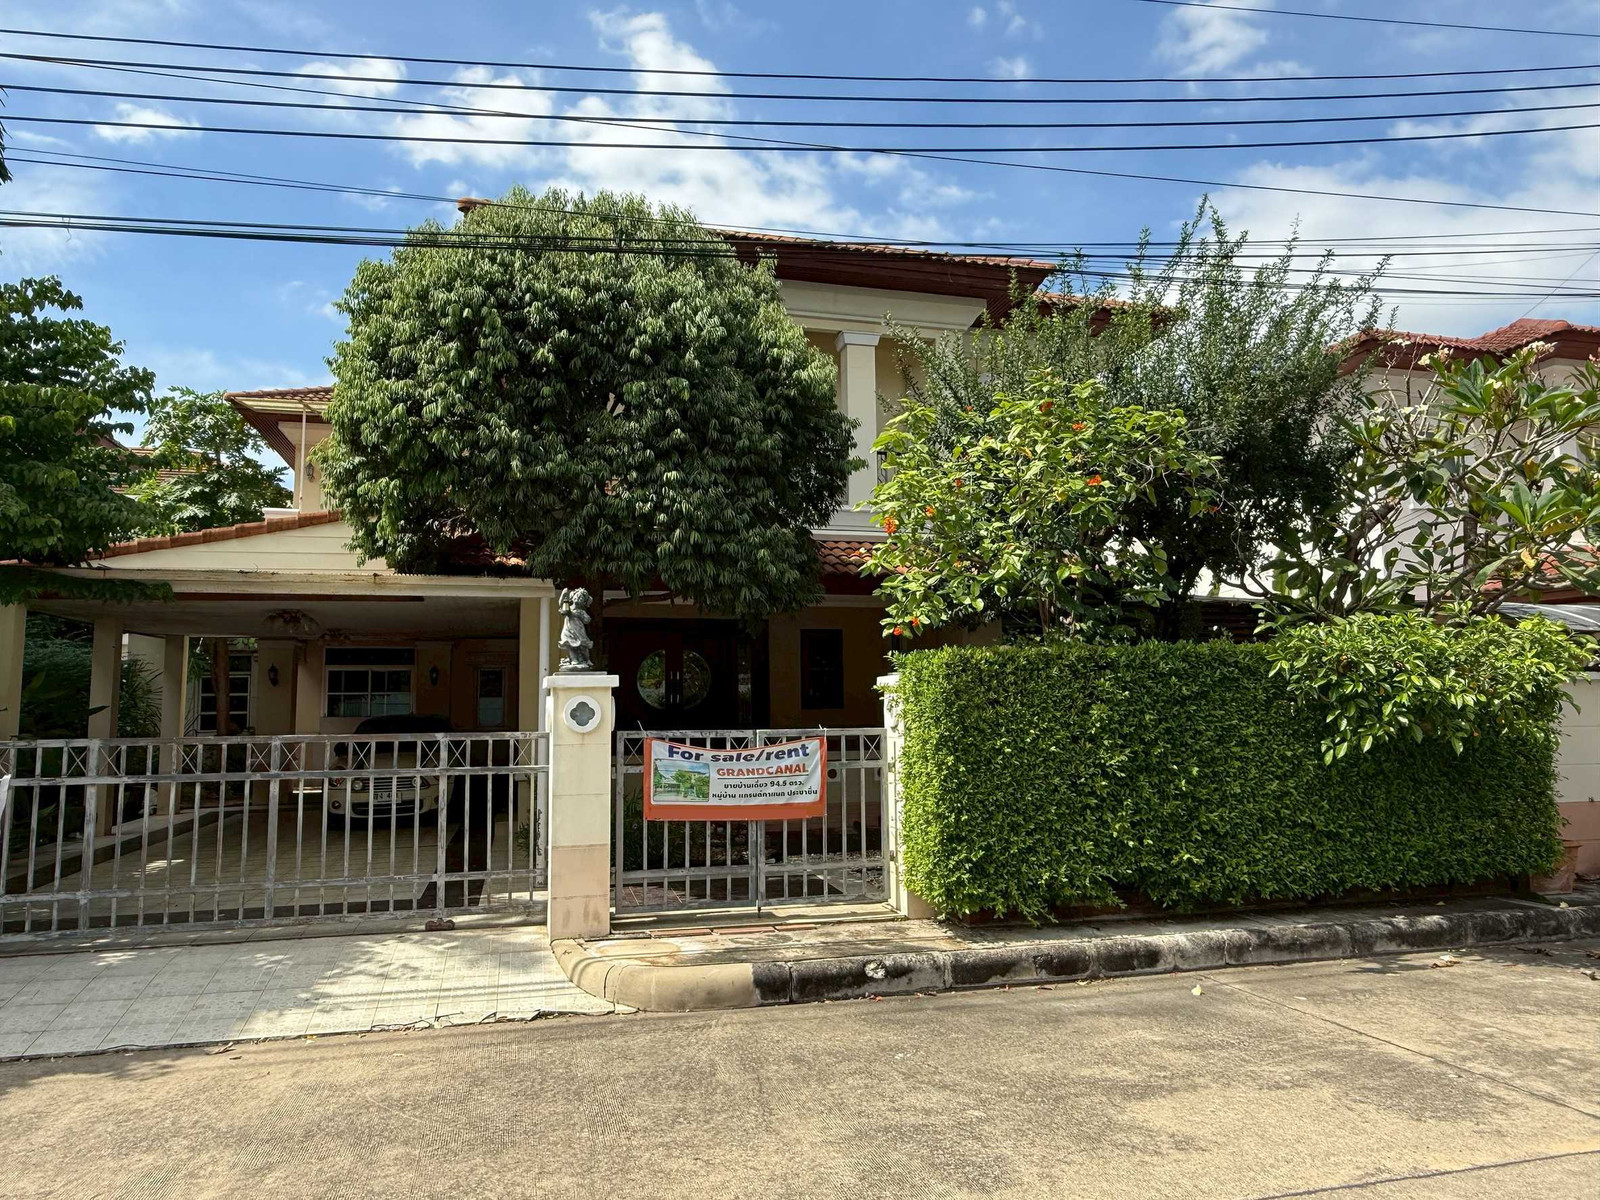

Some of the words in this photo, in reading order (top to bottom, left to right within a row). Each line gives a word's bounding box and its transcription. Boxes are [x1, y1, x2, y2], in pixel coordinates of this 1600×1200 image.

[667, 744, 704, 762] For
[710, 743, 810, 763] sale/rent
[716, 763, 809, 777] GRANDCANAL
[712, 791, 736, 800] หมู่บ้าน
